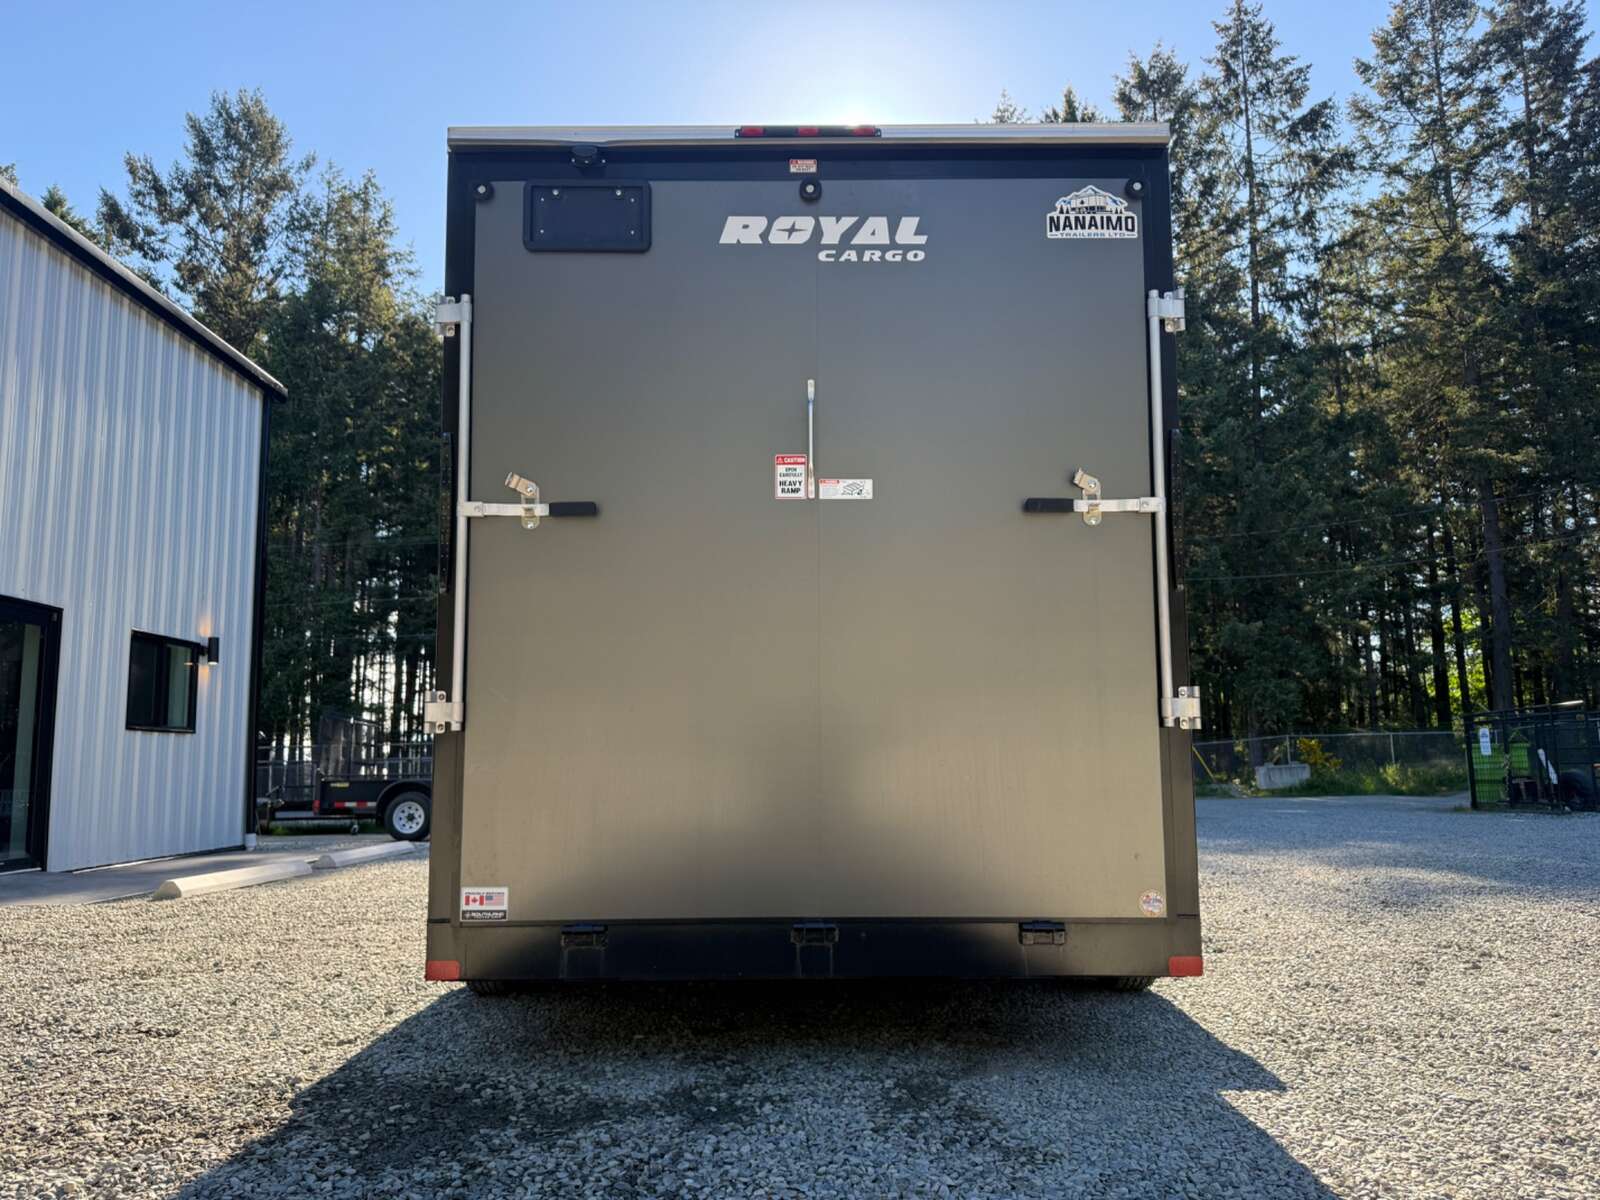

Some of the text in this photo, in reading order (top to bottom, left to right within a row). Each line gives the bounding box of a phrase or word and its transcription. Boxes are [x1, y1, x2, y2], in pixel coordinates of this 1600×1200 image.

[719, 216, 928, 244] ROYAL
[1049, 215, 1135, 232] NANAIMO
[818, 250, 926, 262] CARGO
